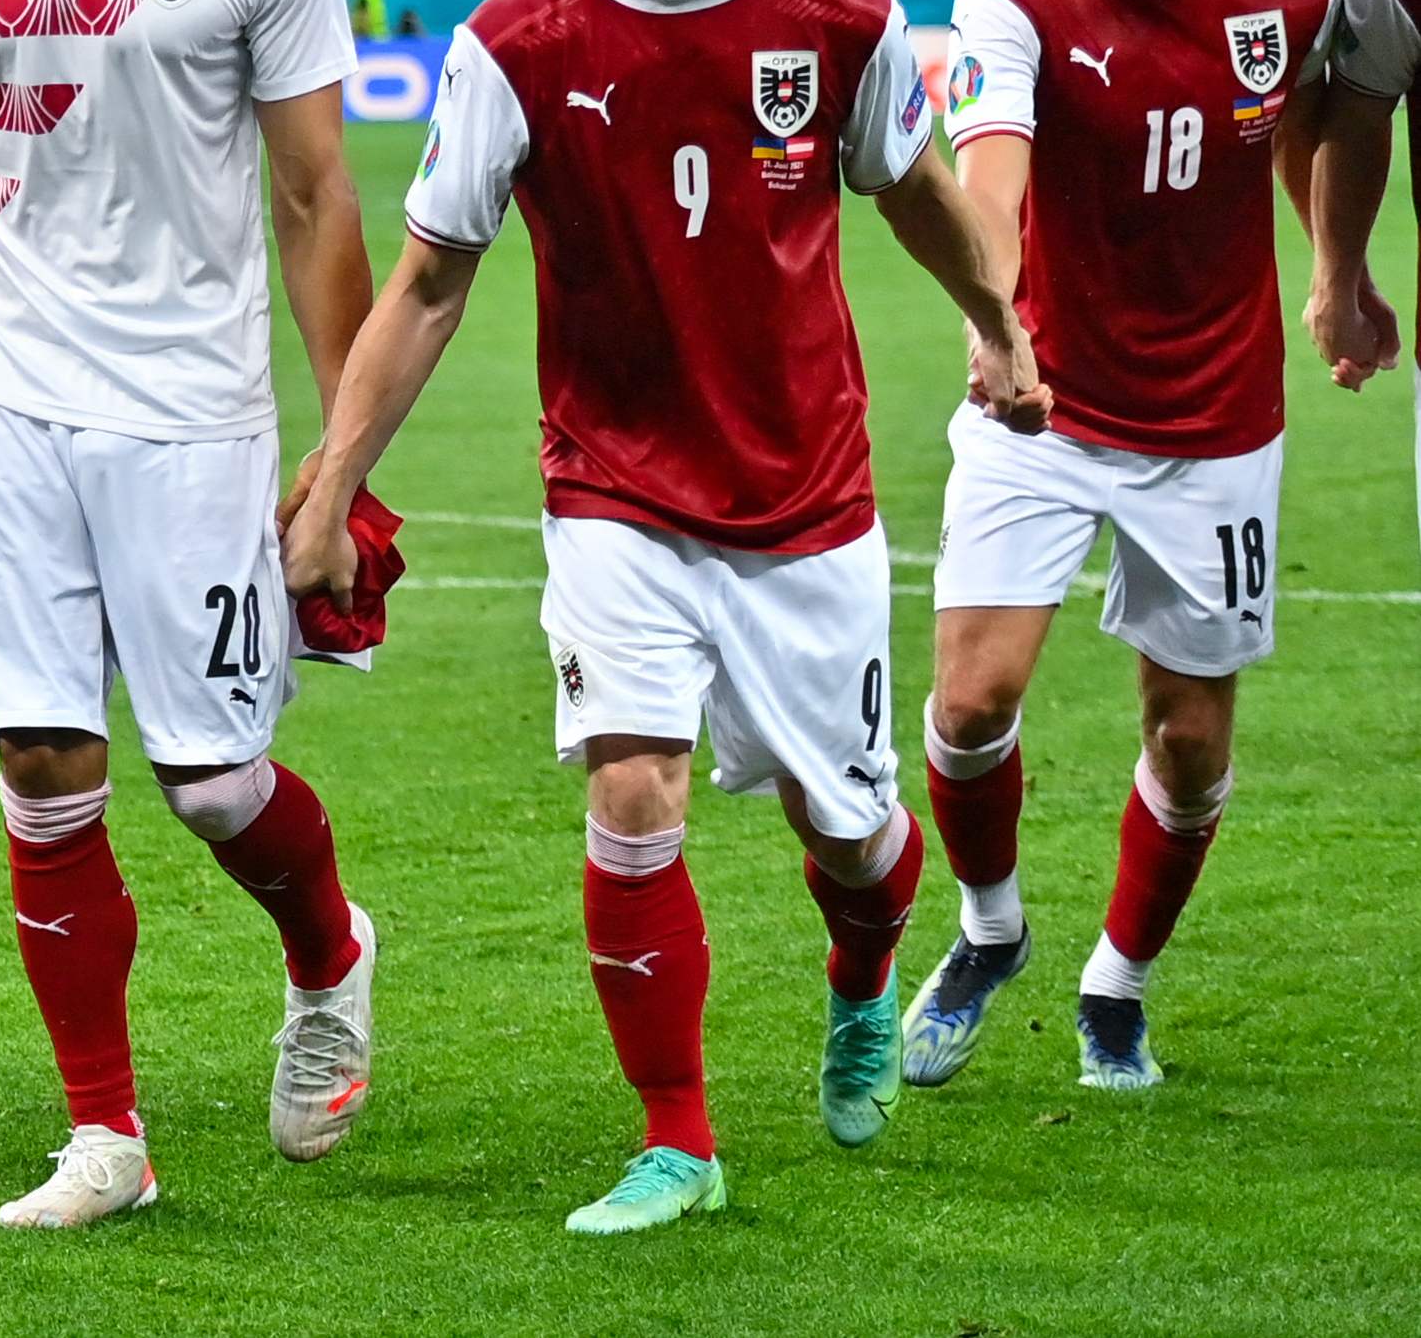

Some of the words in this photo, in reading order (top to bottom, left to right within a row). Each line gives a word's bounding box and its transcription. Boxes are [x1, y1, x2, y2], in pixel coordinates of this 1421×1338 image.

[673, 145, 709, 238] 9
[1143, 107, 1203, 193] 18
[1216, 517, 1265, 609] 18
[205, 583, 261, 678] 20
[862, 658, 881, 751] 9
